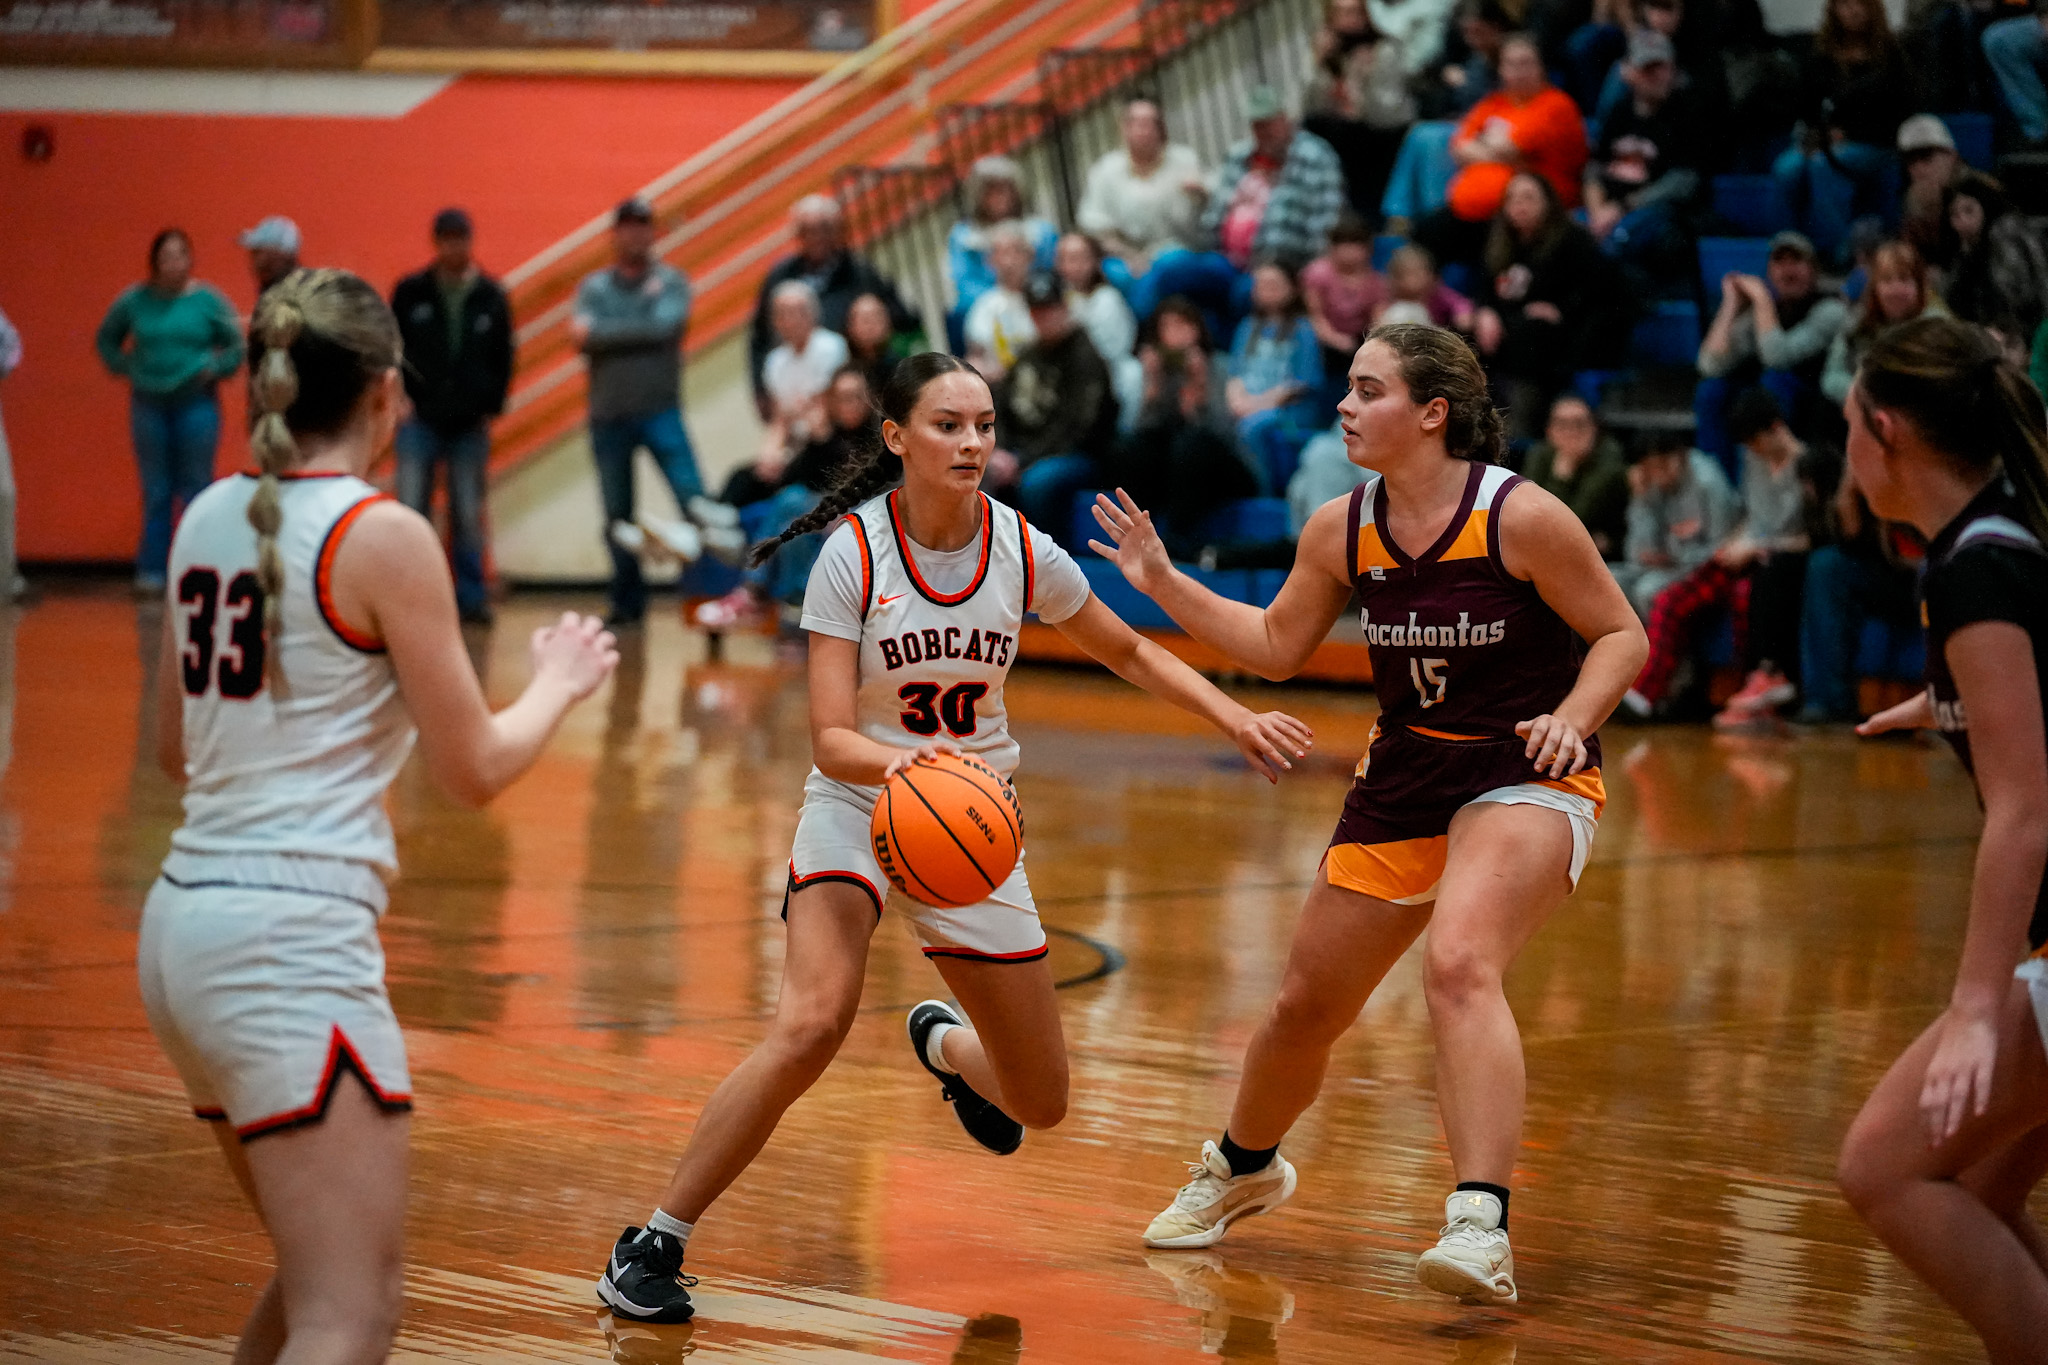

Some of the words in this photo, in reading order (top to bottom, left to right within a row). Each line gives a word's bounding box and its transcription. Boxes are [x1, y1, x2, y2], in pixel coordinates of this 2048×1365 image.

[178, 564, 267, 703] 33
[879, 627, 1012, 671] BOBCATS
[1360, 607, 1505, 647] Pocahontas
[1410, 657, 1449, 709] 15
[898, 682, 989, 738] 30
[966, 806, 992, 838] NFHS
